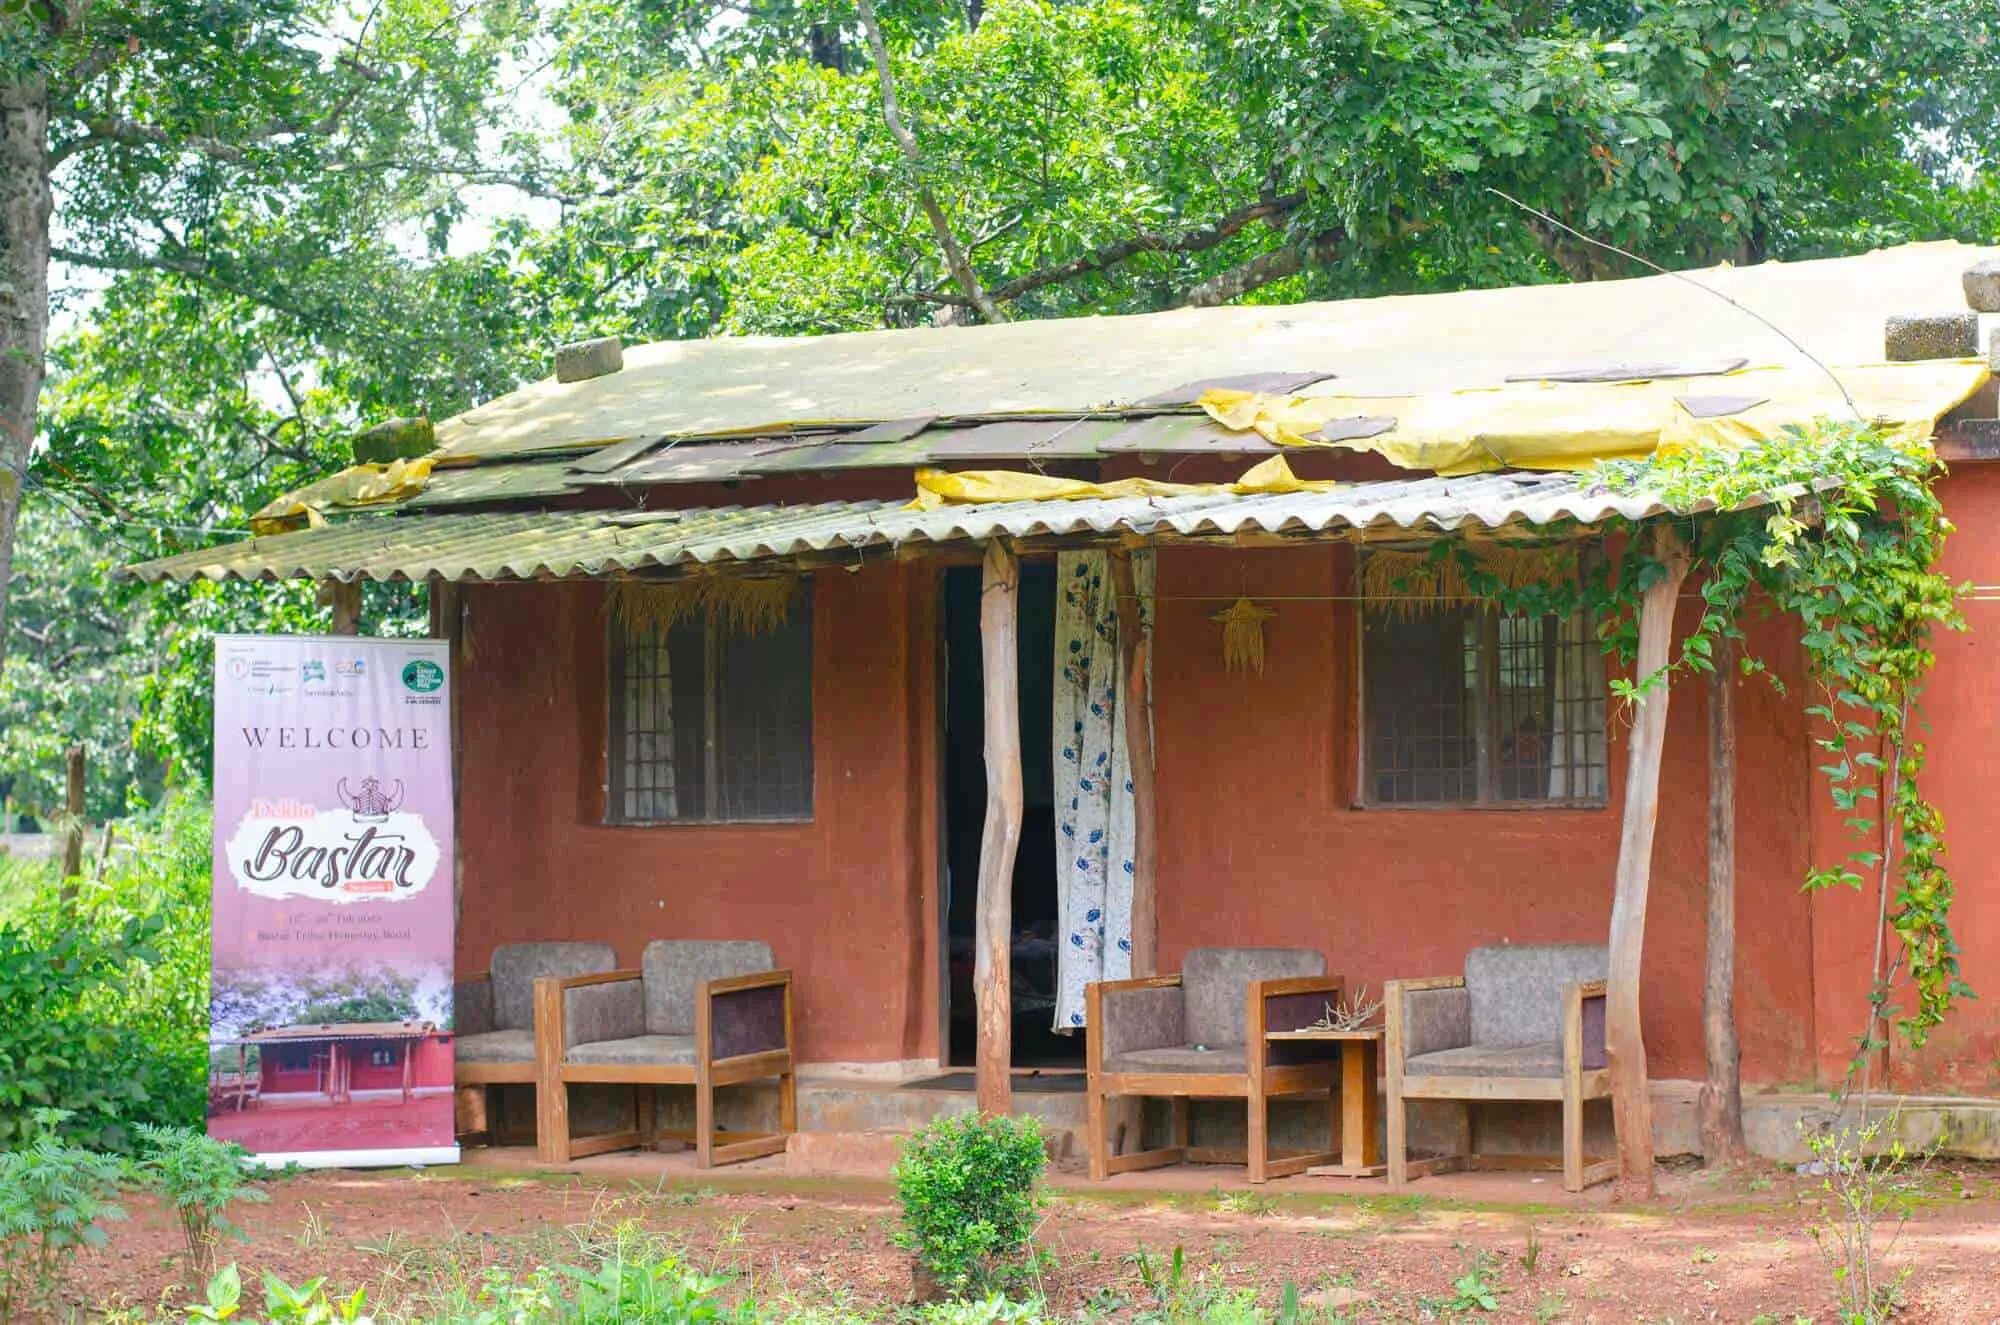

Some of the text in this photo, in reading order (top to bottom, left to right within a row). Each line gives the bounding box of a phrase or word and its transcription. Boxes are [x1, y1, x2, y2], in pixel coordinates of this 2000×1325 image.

[242, 727, 430, 749] WELCOME
[253, 800, 315, 819] Dekho
[243, 825, 416, 888] Bastar
